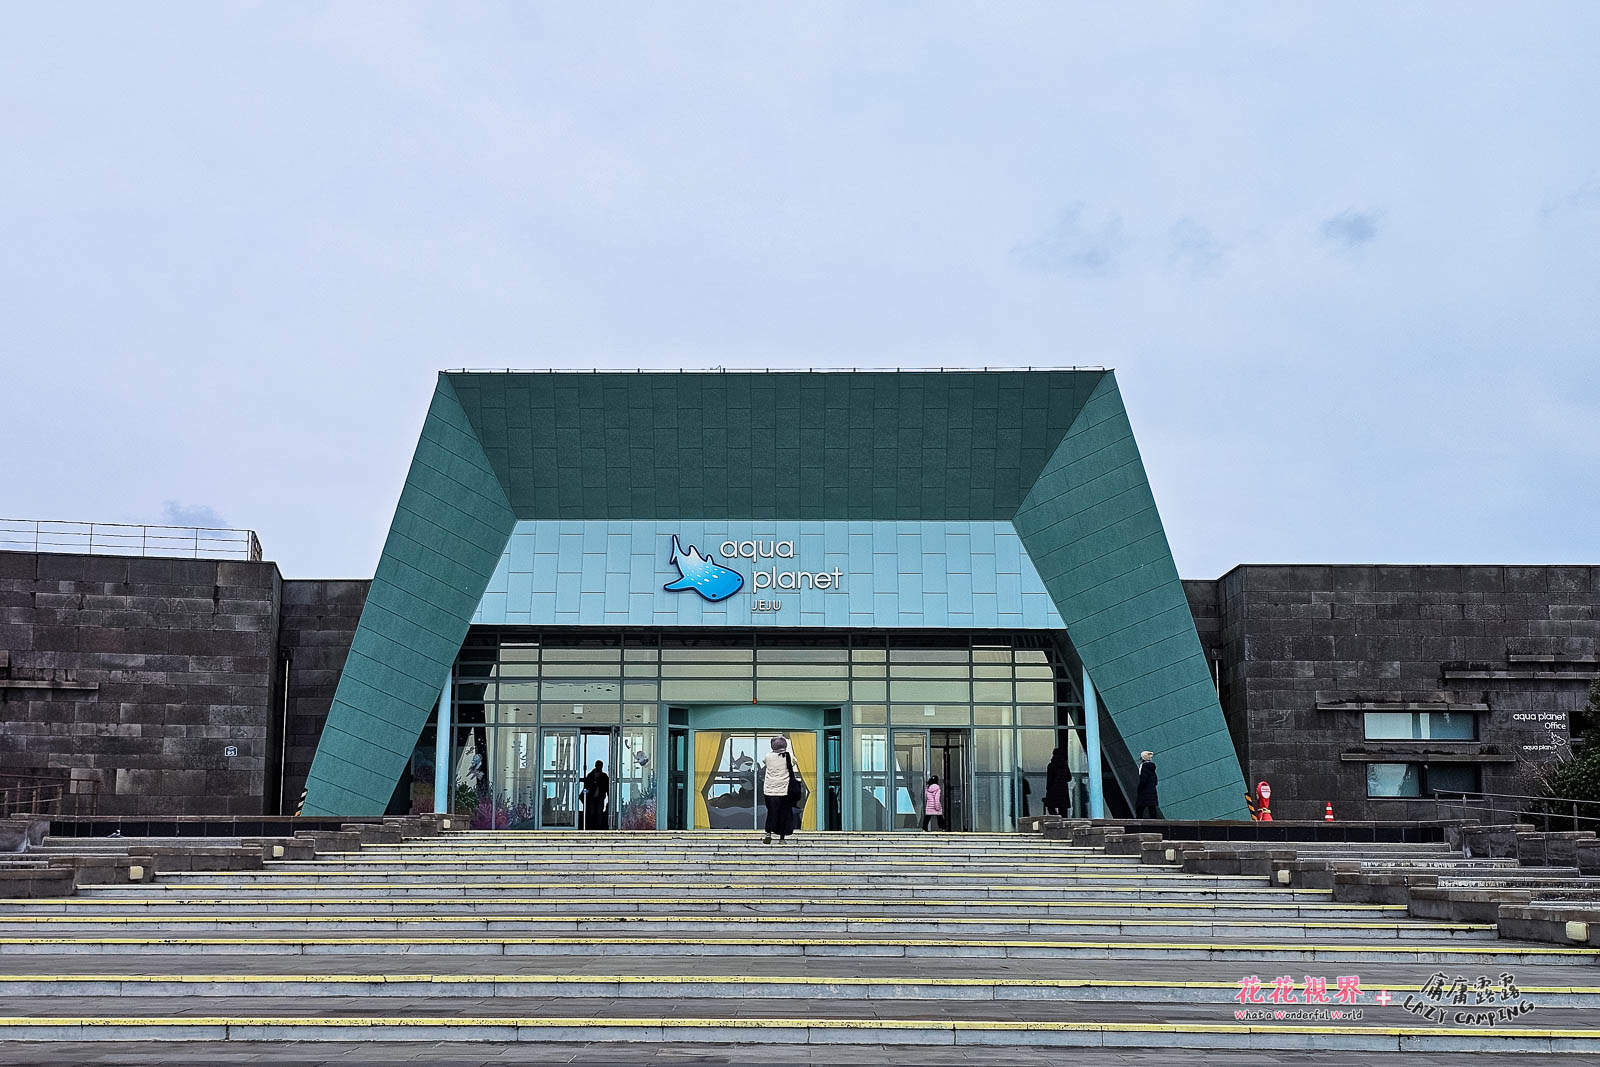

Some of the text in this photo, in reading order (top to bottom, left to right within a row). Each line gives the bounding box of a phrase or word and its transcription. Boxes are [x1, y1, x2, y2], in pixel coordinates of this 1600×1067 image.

[720, 540, 794, 562] aqua
[753, 566, 843, 593] planet
[752, 599, 781, 611] JEJU
[1513, 712, 1566, 721] aqua planet
[1544, 722, 1566, 730] Office
